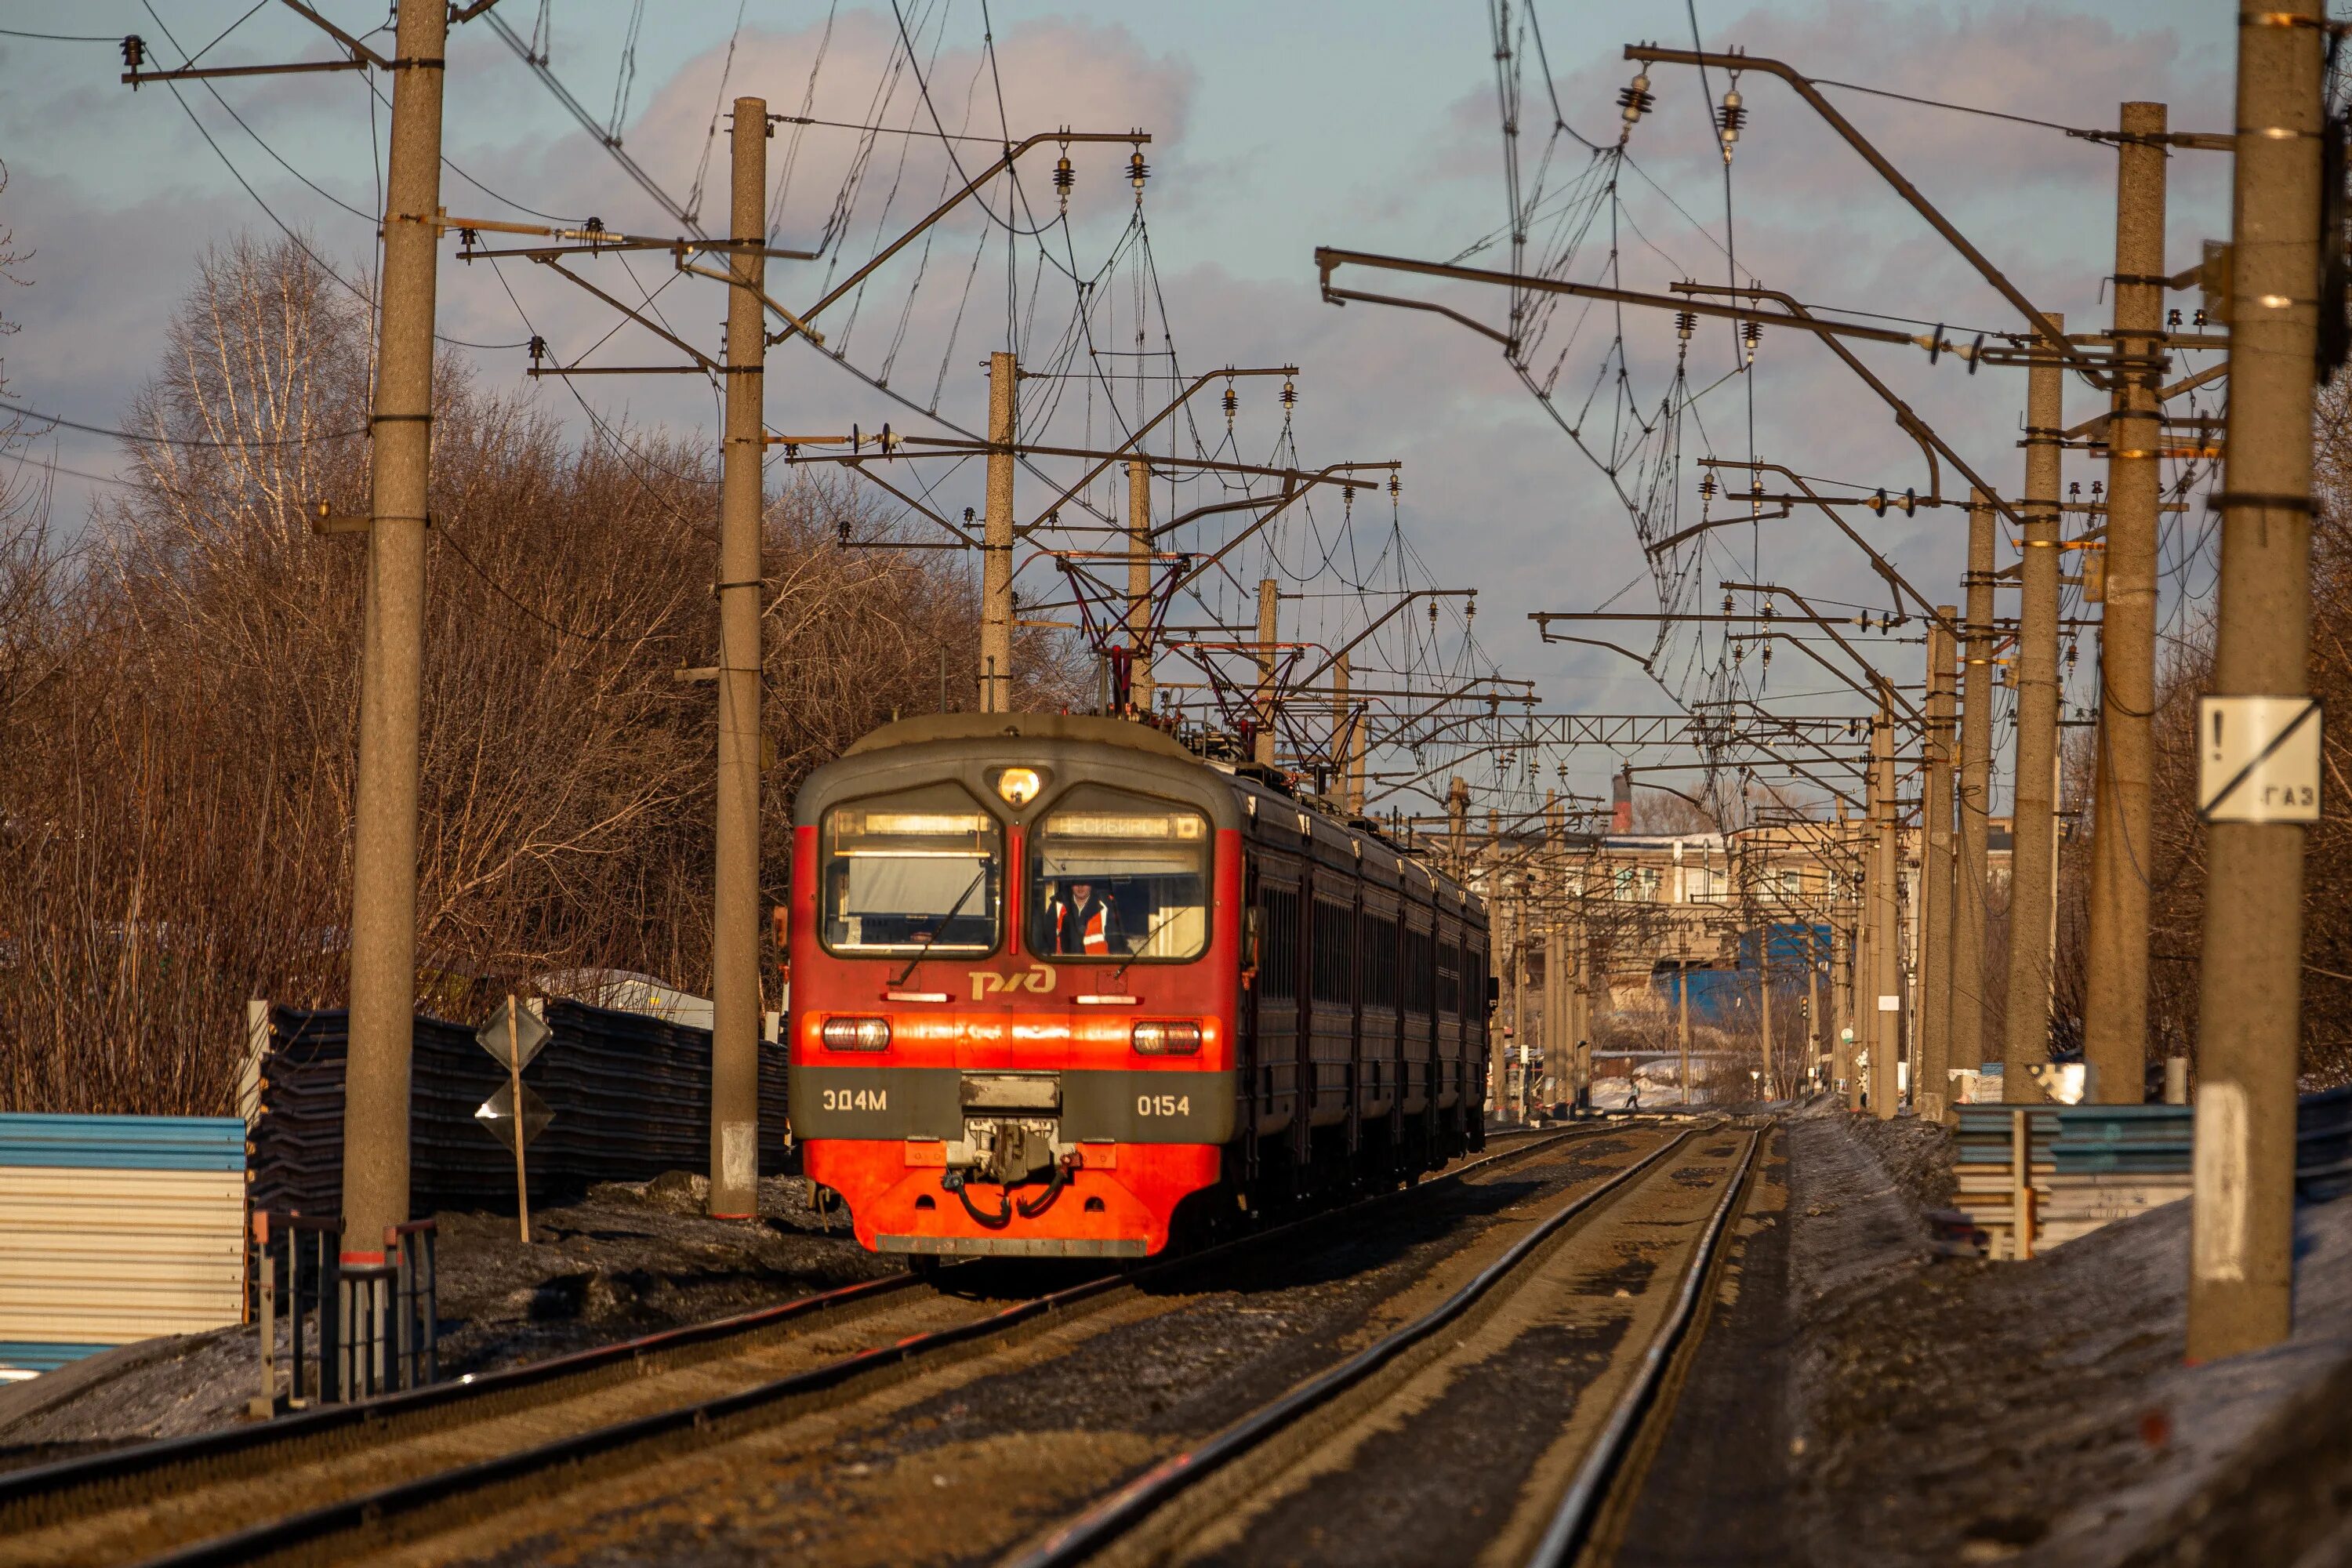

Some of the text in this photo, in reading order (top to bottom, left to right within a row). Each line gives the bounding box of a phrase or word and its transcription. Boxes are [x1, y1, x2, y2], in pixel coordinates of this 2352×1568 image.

[2265, 787, 2314, 806] ГАЗ
[968, 964, 1056, 1000] РЖД
[823, 1089, 887, 1110] ЭД4М
[1138, 1095, 1189, 1116] 0154
